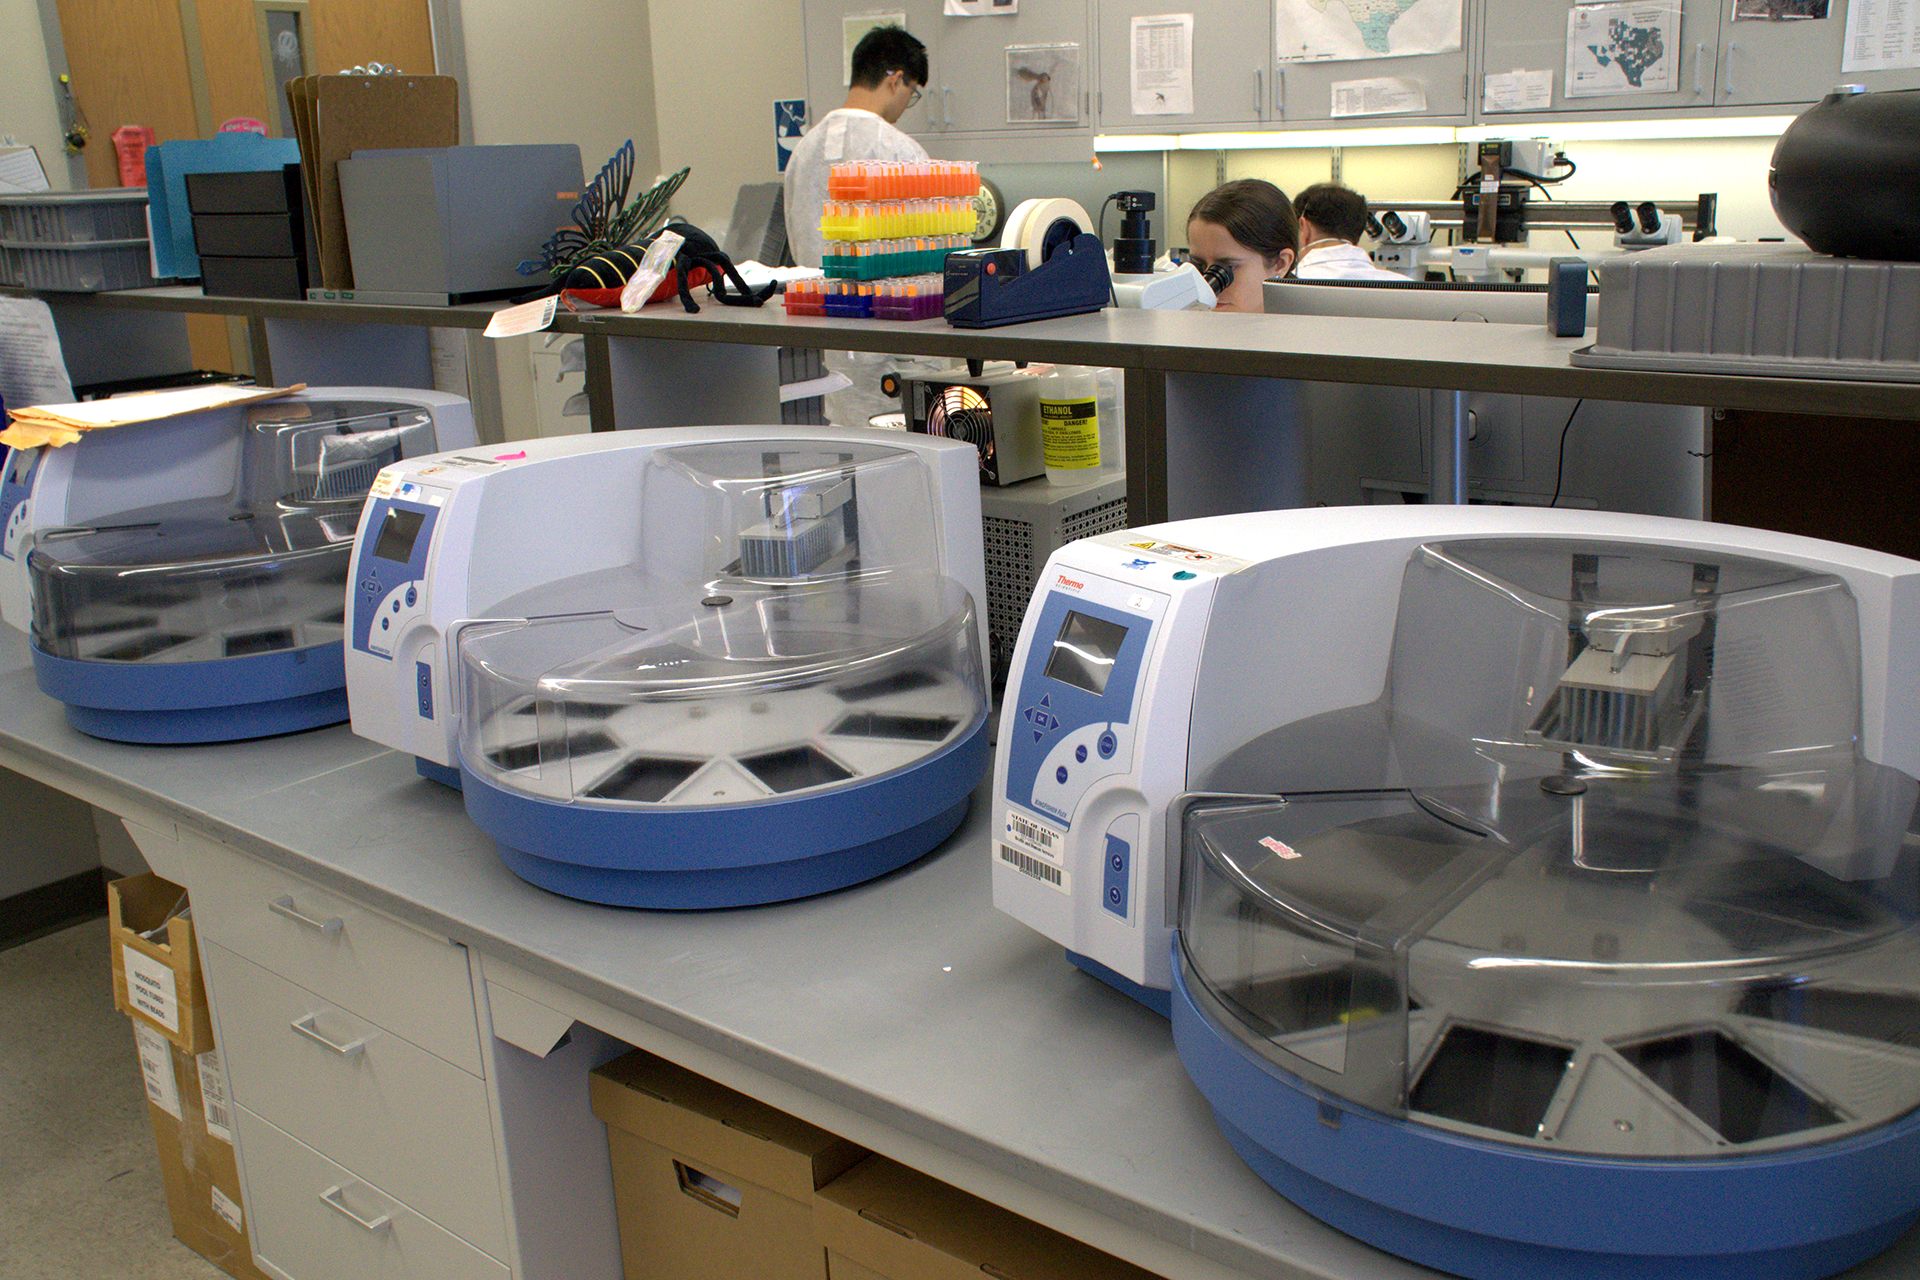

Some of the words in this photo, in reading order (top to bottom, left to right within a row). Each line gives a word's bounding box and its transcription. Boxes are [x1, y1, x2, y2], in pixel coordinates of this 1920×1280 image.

[987, 198, 992, 206] 2
[1043, 406, 1072, 414] ETHANOL
[1055, 584, 1080, 593] SCIENTIFIC
[1057, 575, 1084, 589] Thermo
[1037, 715, 1045, 723] OK
[1011, 814, 1027, 824] STATE
[1041, 827, 1059, 839] TEXAS
[134, 971, 161, 989] MOSQUITO
[135, 984, 148, 996] POOL
[149, 991, 163, 1004] TUBES
[137, 998, 149, 1009] WITH
[150, 1005, 165, 1019] BEADS
